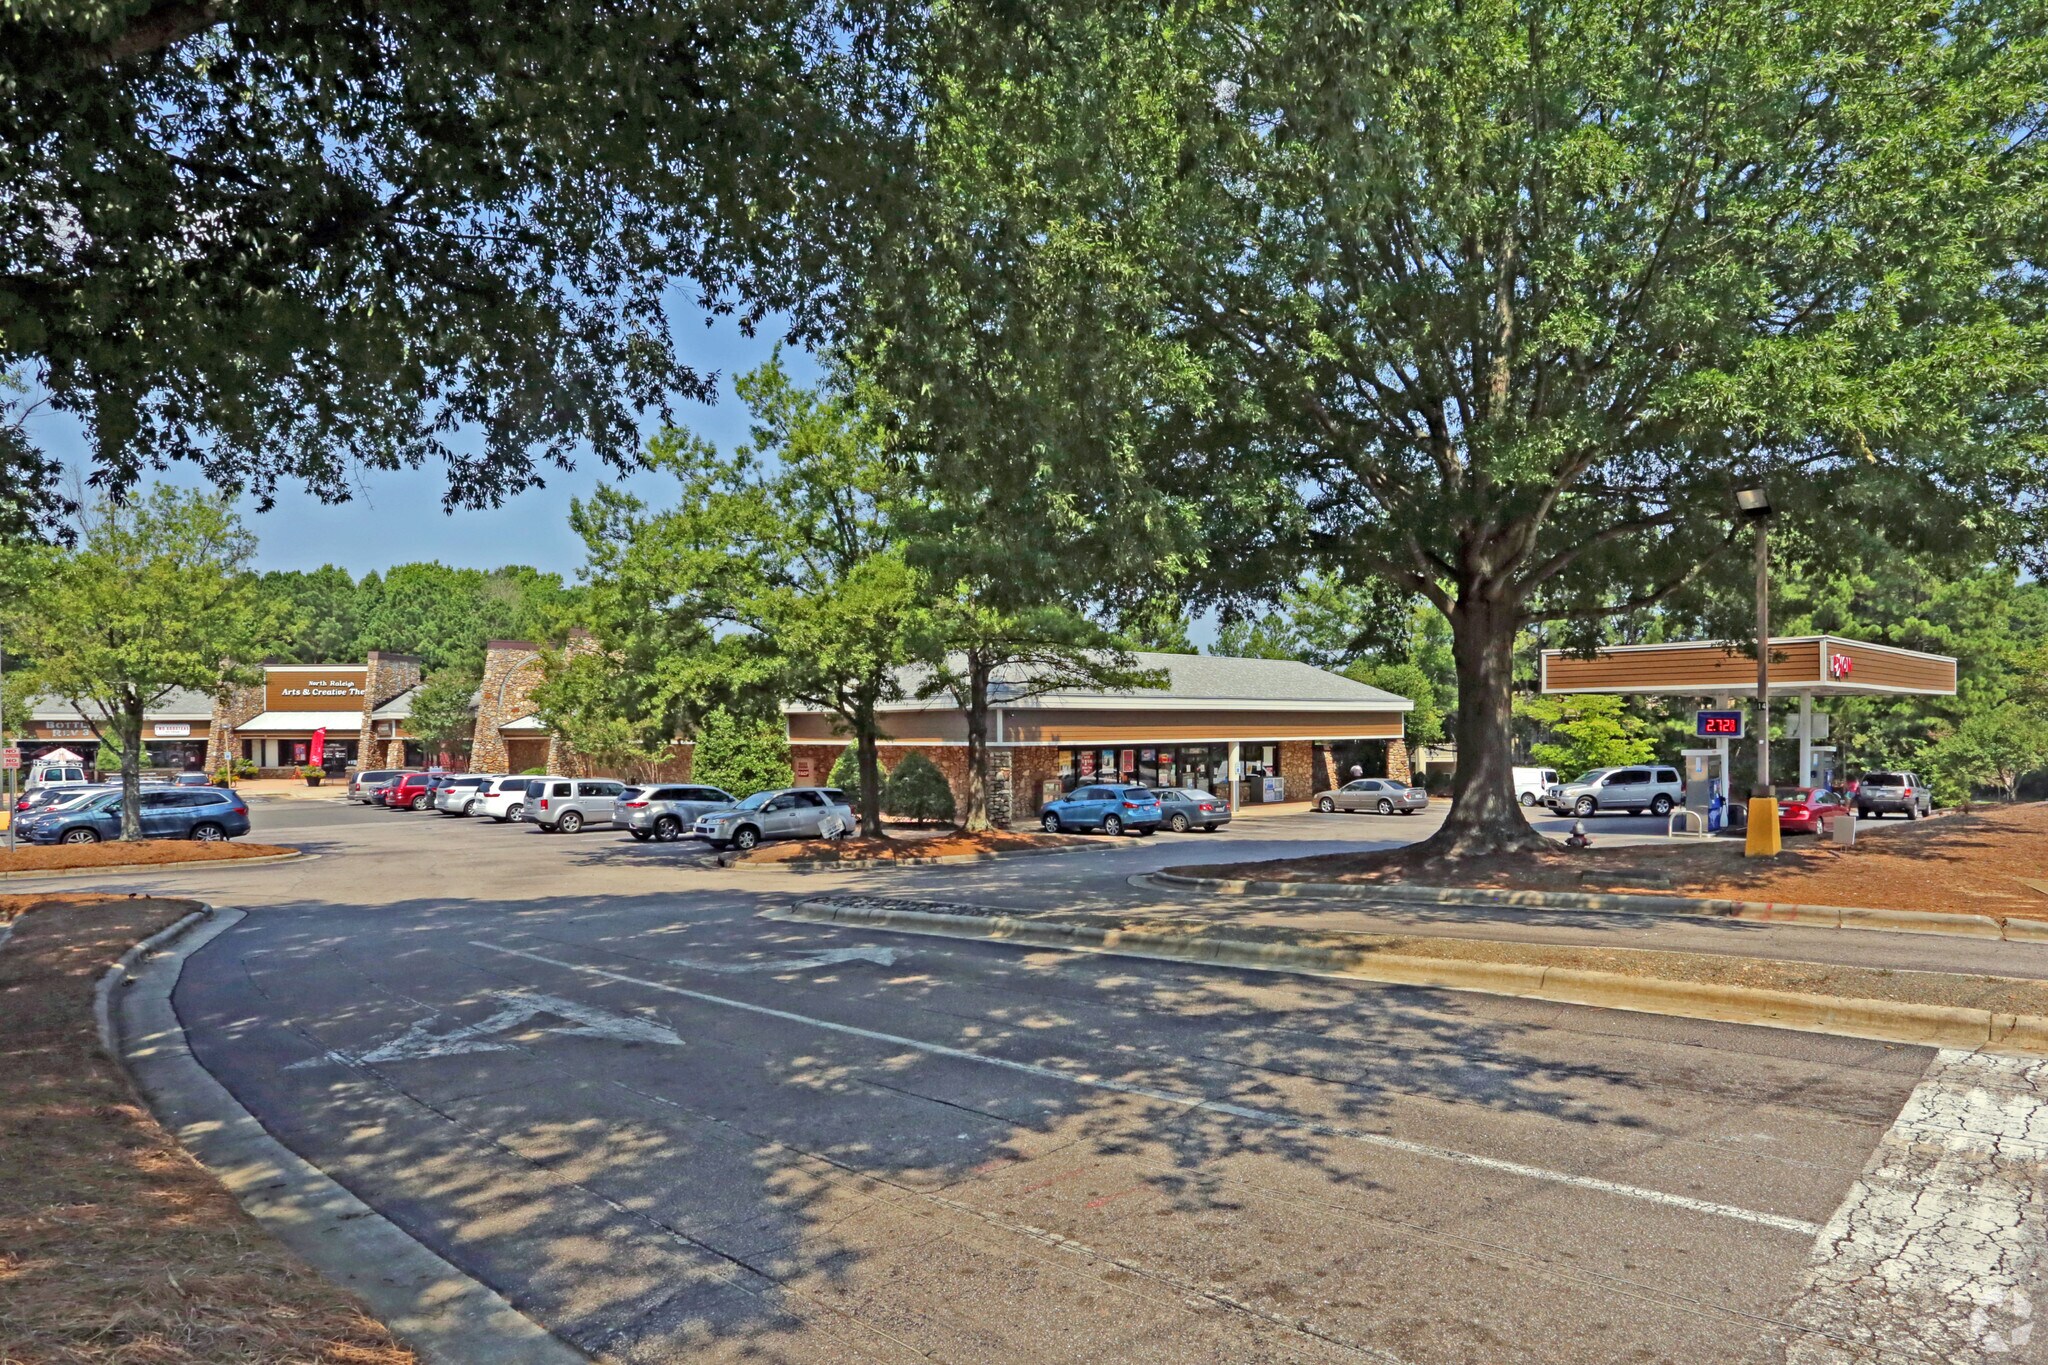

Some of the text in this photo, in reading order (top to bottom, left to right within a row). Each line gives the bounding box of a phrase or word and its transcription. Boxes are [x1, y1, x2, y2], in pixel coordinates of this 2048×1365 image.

[329, 680, 355, 688] Raleigh
[281, 688, 366, 696] Arts & Creative The
[45, 721, 91, 729] BOTTL
